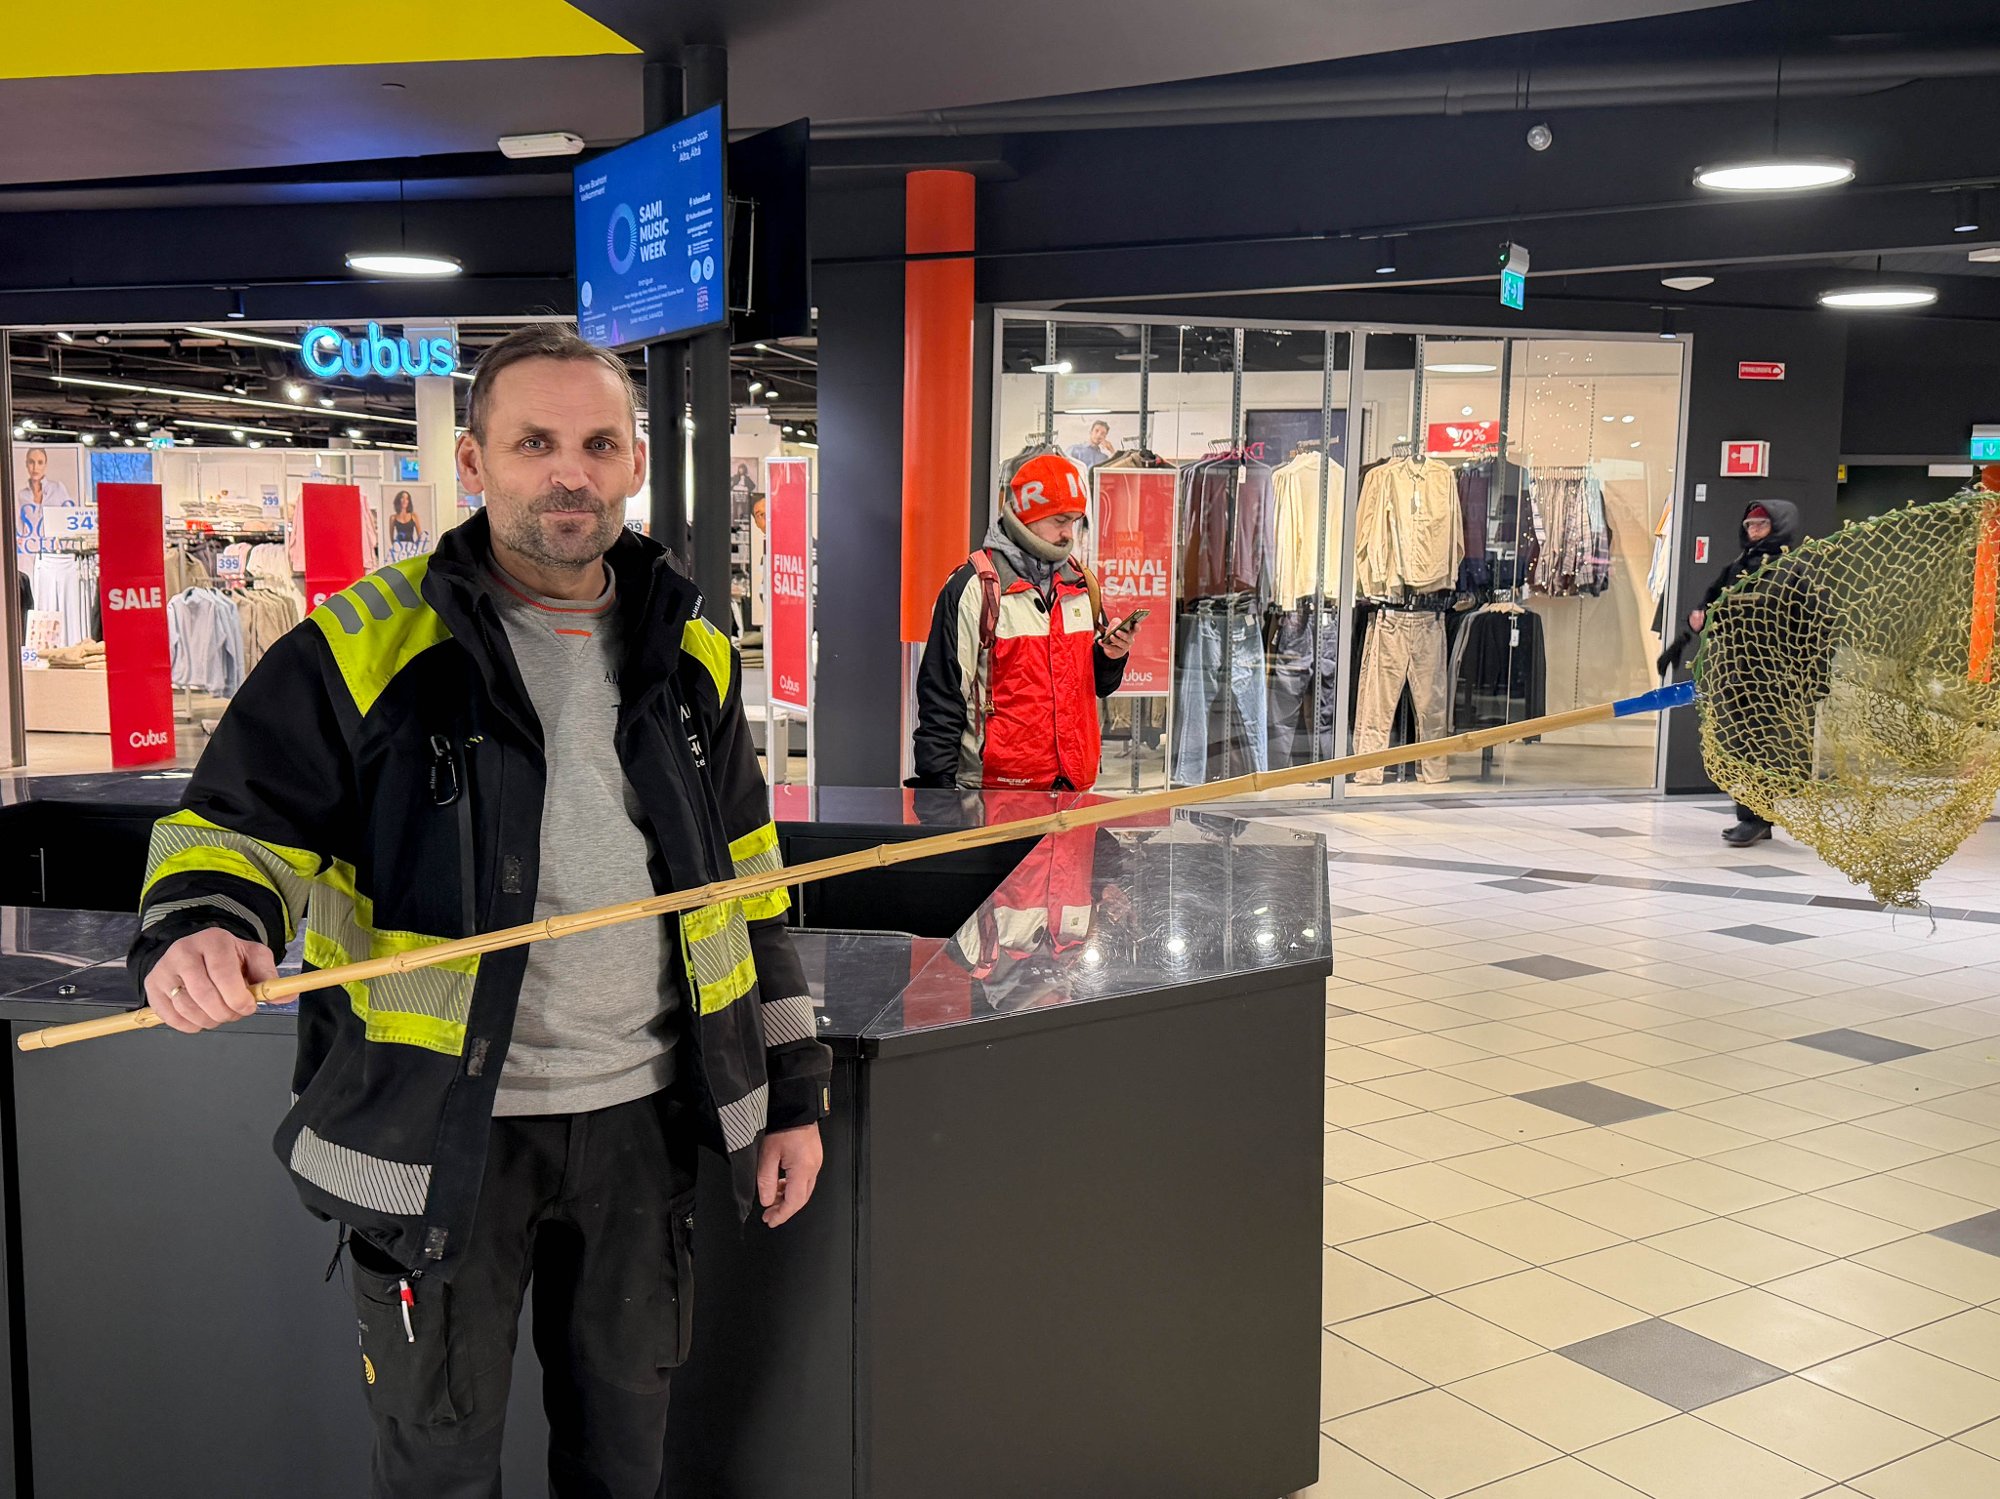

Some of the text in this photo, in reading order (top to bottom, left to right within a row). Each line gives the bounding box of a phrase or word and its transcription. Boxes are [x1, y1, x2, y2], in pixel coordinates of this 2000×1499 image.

[639, 199, 663, 224] SAMI
[640, 217, 670, 243] MUSIC
[640, 238, 667, 263] WEEK
[301, 319, 457, 378] Cubus
[262, 496, 279, 506] 299
[67, 515, 99, 530] 34
[219, 558, 239, 570] 399
[773, 554, 805, 575] FINAL
[1104, 559, 1167, 576] FINAL
[773, 572, 806, 598] SALE
[1104, 576, 1167, 597] SALE
[108, 586, 162, 611] SALE
[779, 674, 801, 693] Cubus
[1123, 668, 1153, 682] ubus
[129, 729, 169, 749] Cubus
